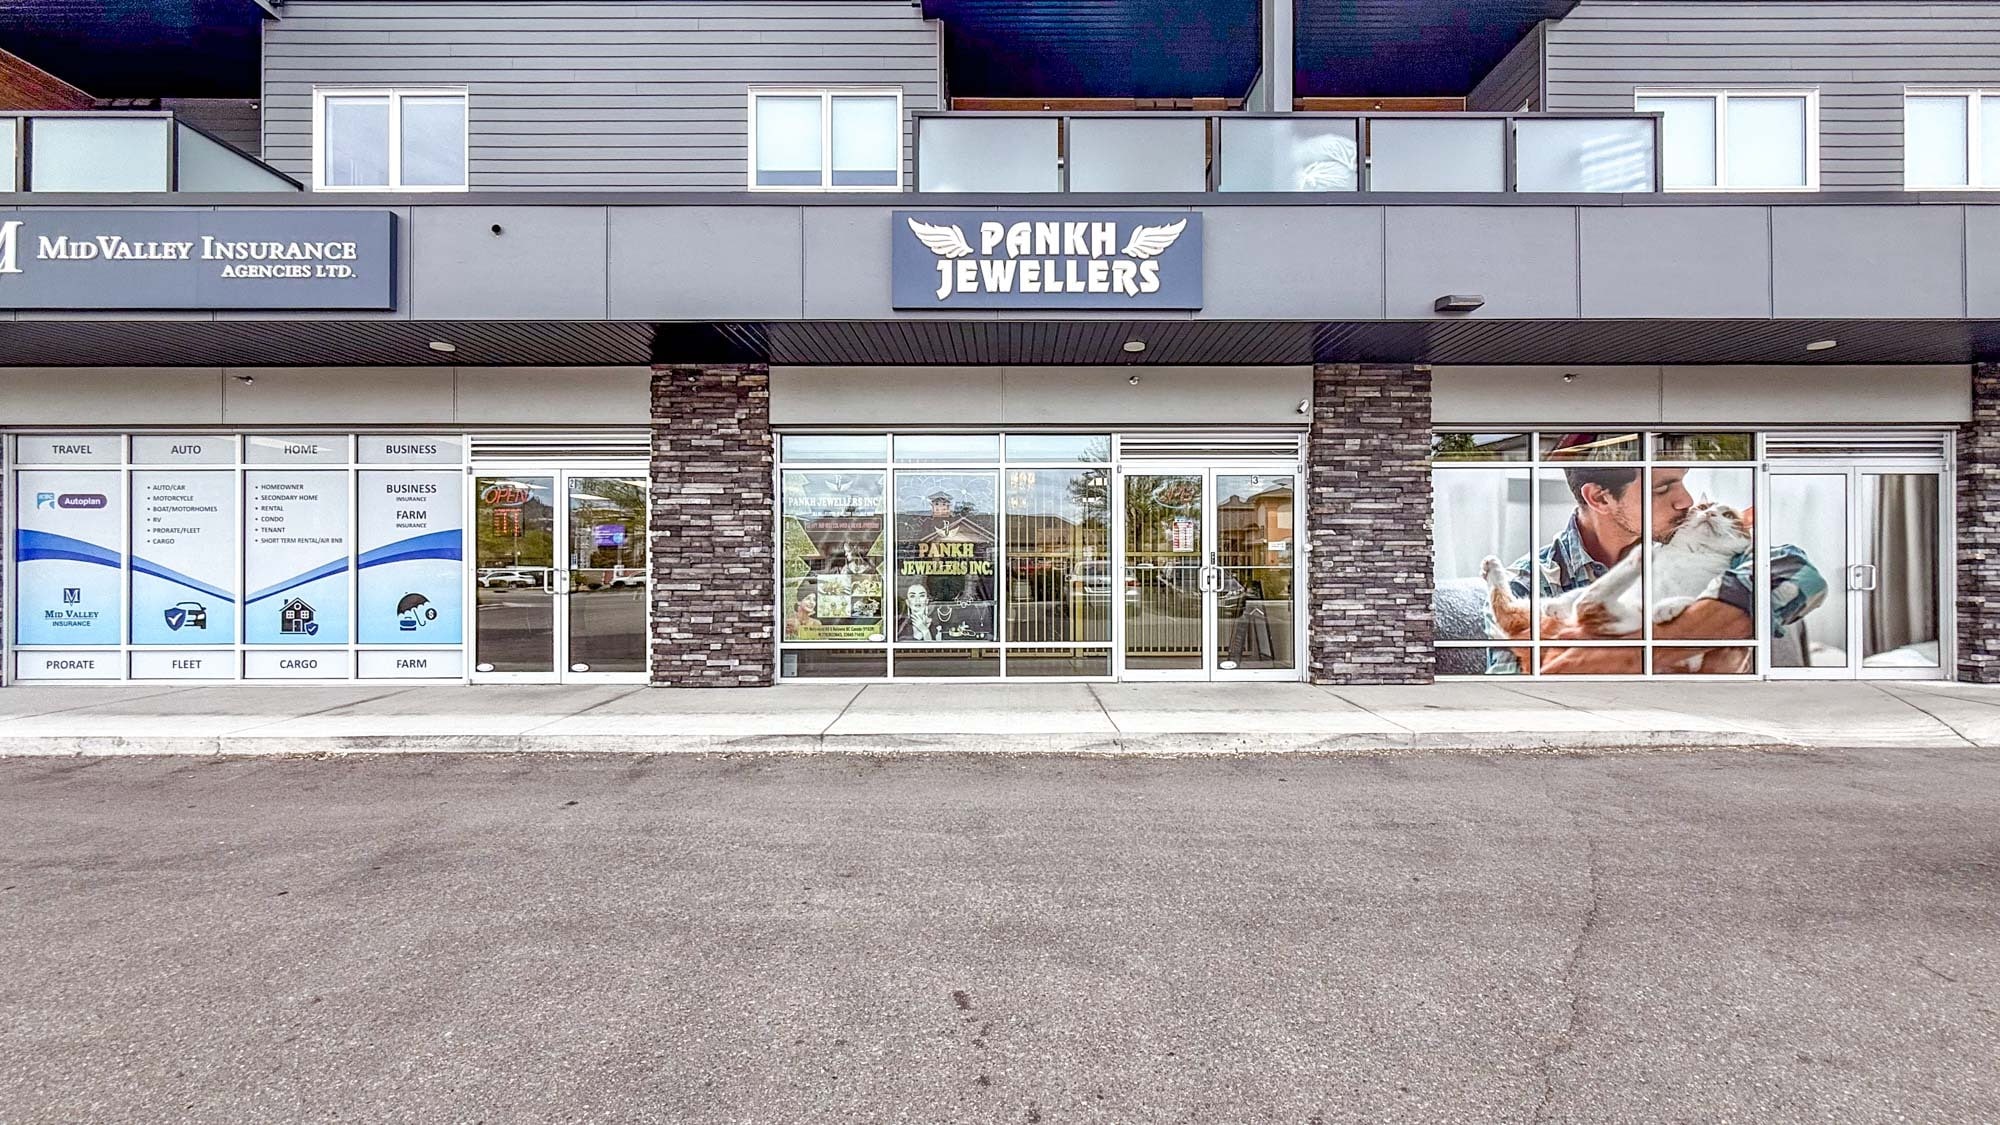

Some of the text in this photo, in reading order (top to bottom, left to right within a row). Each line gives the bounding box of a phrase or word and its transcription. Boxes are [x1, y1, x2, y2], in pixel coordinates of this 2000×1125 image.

[980, 221, 1117, 260] PANKH
[200, 235, 357, 260] INSURANCE
[221, 264, 357, 278] AGENCIES LTD.
[935, 259, 1160, 300] JEWELLERS
[51, 444, 93, 455] TRAVEL
[170, 444, 202, 455] AUTO
[284, 444, 318, 455] HOME
[386, 444, 437, 454] BUSINESS
[1252, 476, 1259, 485] 3
[386, 484, 437, 494] BUSINESS
[485, 488, 528, 504] OPEN
[64, 497, 101, 507] Autoplan
[788, 497, 816, 507] PANKH
[817, 497, 864, 507] JEWELLERS
[396, 510, 427, 520] FARM
[918, 542, 975, 558] PANKH
[900, 560, 994, 576] JEWELLERS INC.
[44, 609, 99, 618] MID VALLEY
[46, 660, 95, 670] PRORATE
[172, 659, 202, 669] FLEET
[279, 659, 318, 669] CARGO
[396, 659, 427, 669] FARM
